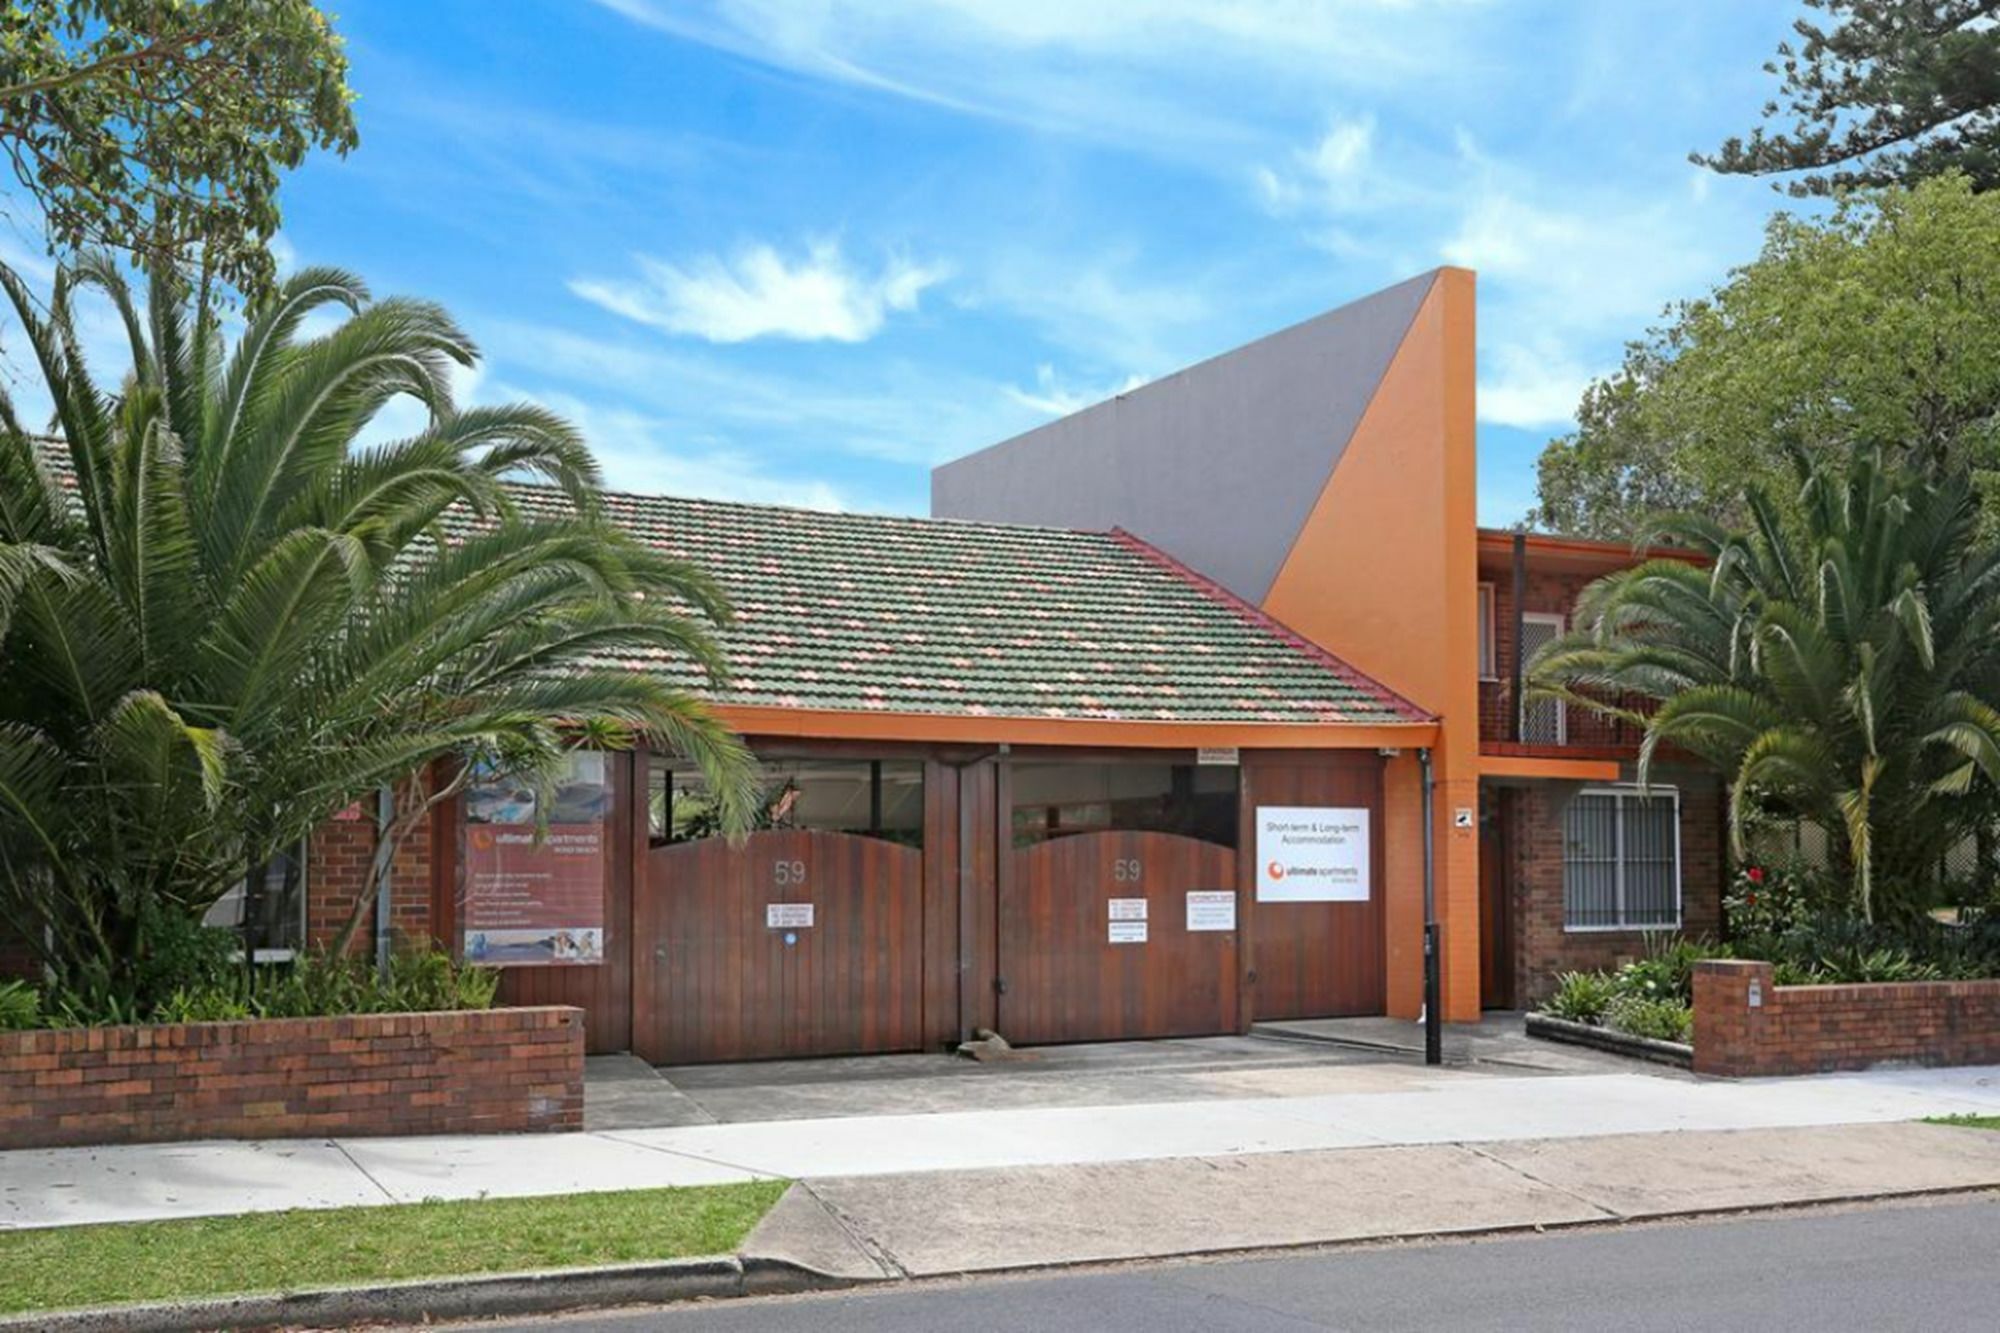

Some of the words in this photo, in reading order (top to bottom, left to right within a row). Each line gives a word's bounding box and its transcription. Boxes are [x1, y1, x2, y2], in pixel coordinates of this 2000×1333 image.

[1311, 822, 1318, 832] &
[1319, 822, 1359, 834] Long-term
[495, 833, 535, 845] ultimat
[1281, 835, 1345, 845] Accommodation
[775, 860, 805, 885] 59
[1114, 859, 1140, 882] 59
[1286, 866, 1317, 876] ultimate
[1319, 866, 1358, 878] apartments
